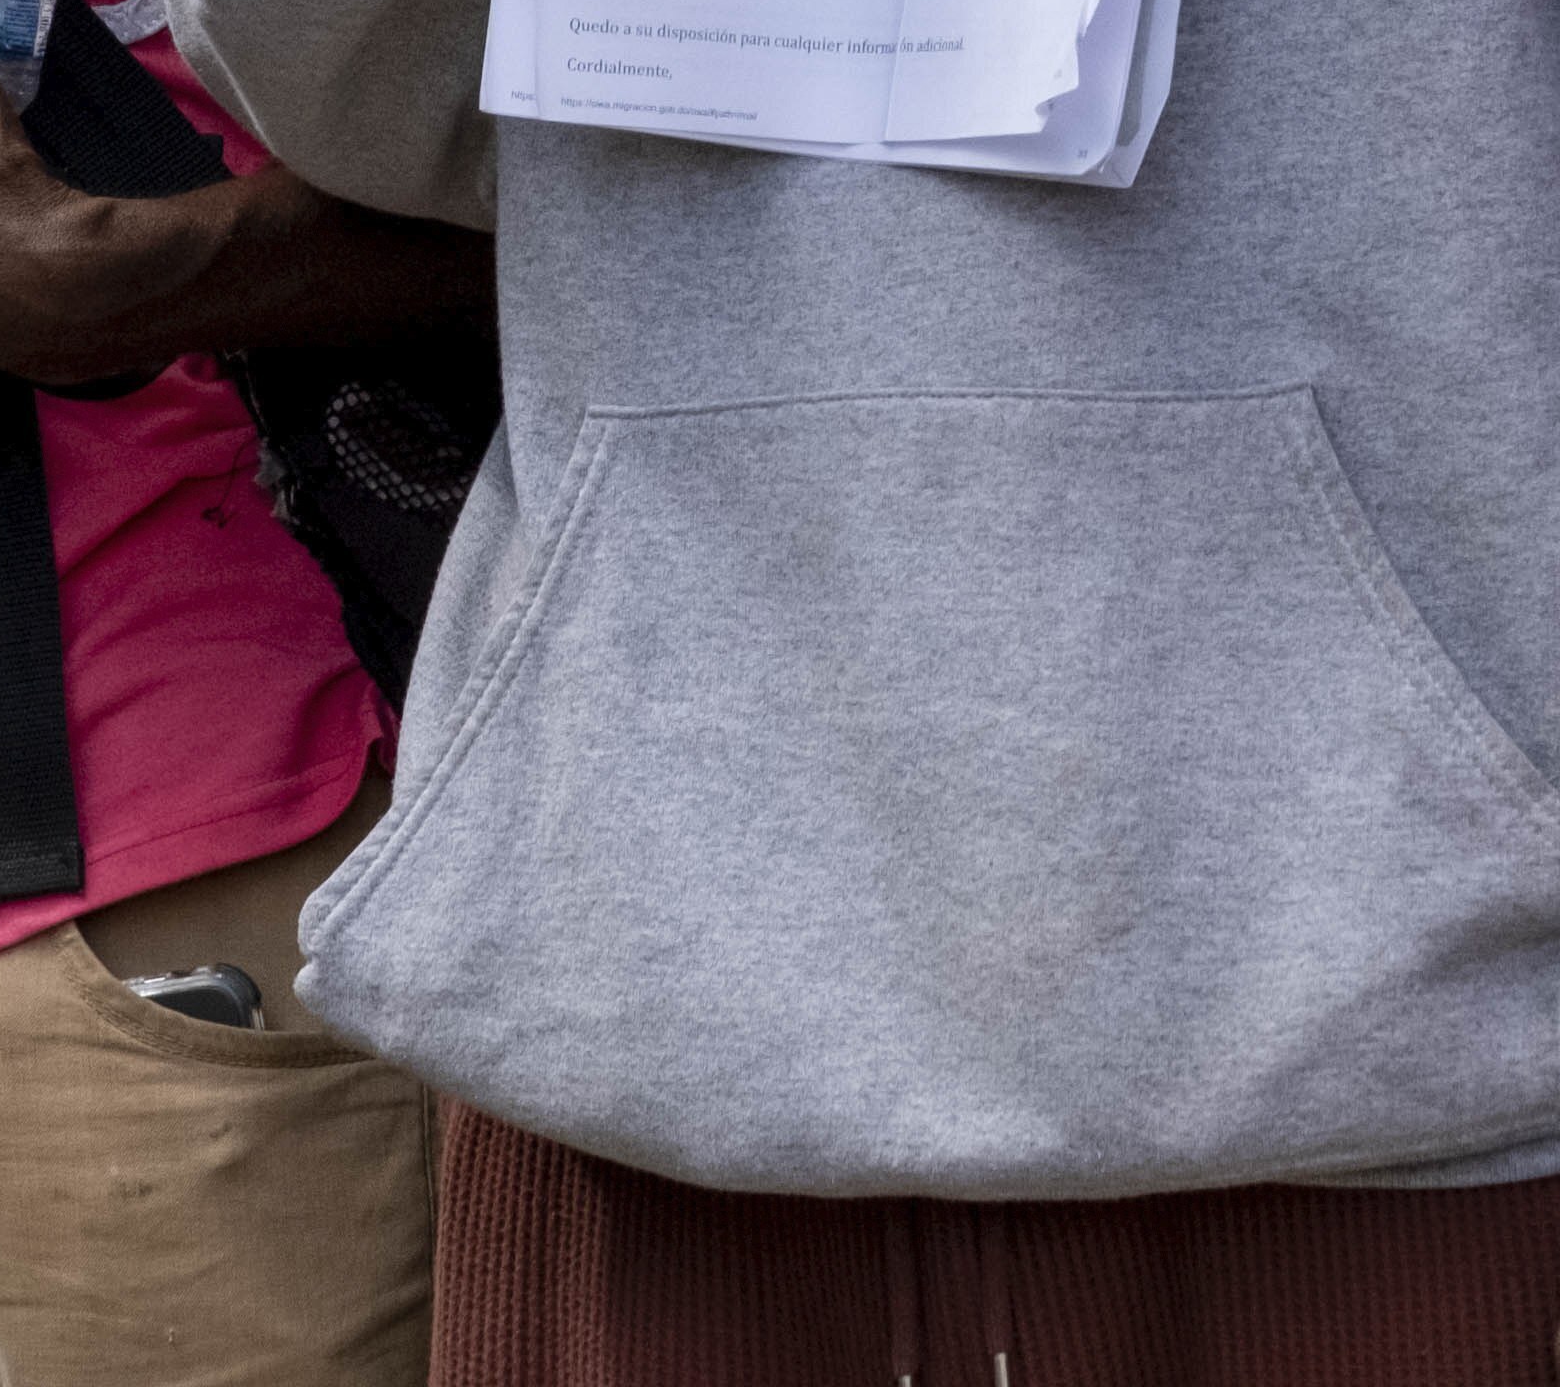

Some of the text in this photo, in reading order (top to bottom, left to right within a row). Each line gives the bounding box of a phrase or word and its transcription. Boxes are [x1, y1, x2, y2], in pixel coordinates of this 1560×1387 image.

[569, 16, 842, 55] Quedo a su disposición para cualquier
[567, 57, 673, 81] Cordialmente,
